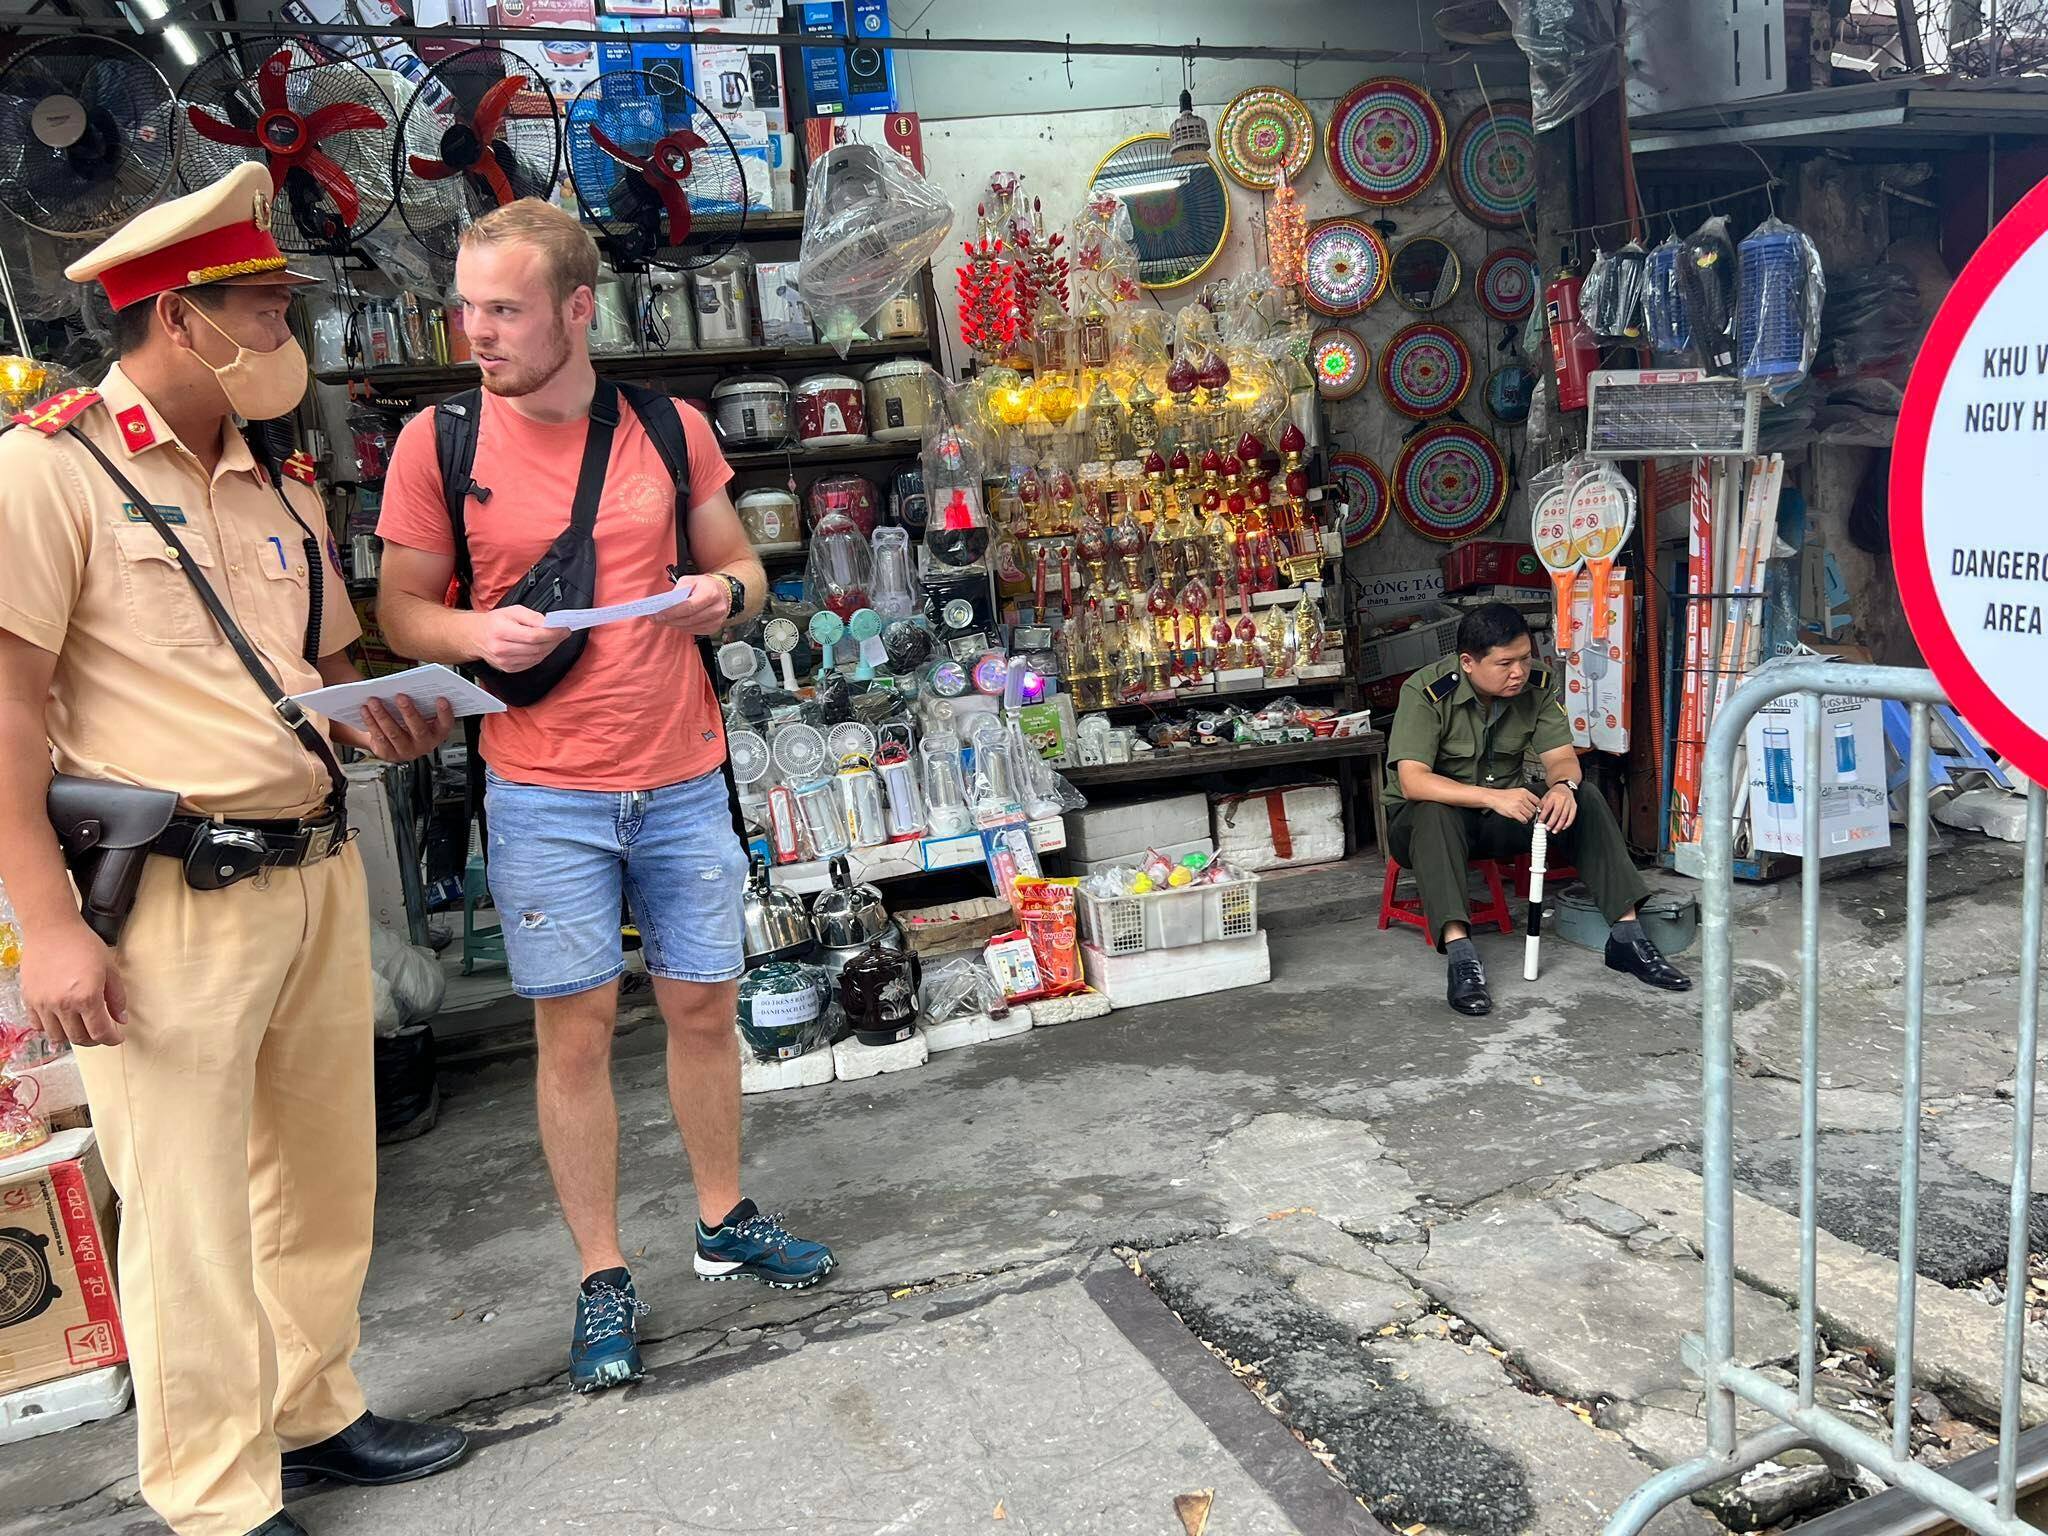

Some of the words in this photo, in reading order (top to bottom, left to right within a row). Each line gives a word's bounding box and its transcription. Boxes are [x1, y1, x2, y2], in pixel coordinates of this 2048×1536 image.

[1983, 345, 2028, 378] KHU
[375, 398, 411, 406] SOKANY
[1965, 401, 2026, 432] NGUY
[1362, 580, 1408, 597] CÔNG
[1412, 574, 1445, 592] TÁC
[1367, 597, 1389, 606] tháng
[1400, 594, 1416, 602] năm
[1983, 602, 2042, 635] AREA
[75, 1234, 97, 1262] BỀN
[97, 1326, 111, 1353] TICO
